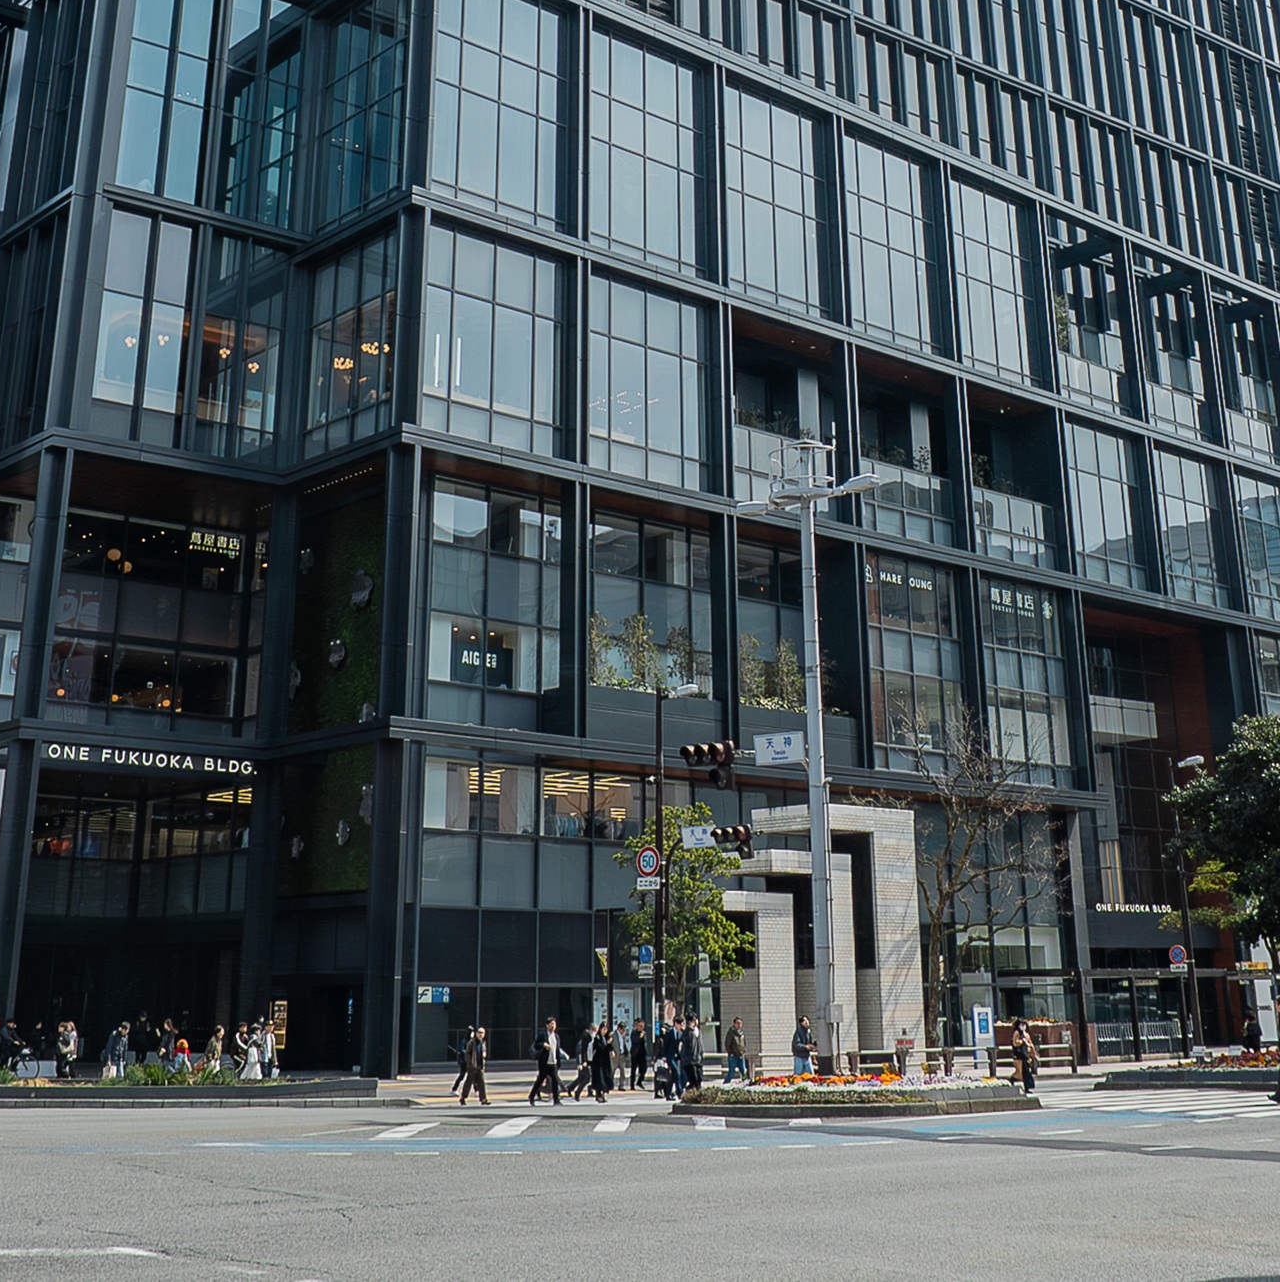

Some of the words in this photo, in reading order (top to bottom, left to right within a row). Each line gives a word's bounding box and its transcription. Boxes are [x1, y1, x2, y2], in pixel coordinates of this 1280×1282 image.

[190, 531, 240, 550] 蔦屋書店
[879, 570, 902, 585] HARE
[461, 649, 492, 668] AIGE
[765, 736, 792, 750] 天神
[47, 743, 90, 761] ONE
[101, 748, 194, 769] FUKUOKA
[203, 757, 258, 775] BLDG.
[641, 854, 656, 869] 50
[1095, 902, 1113, 913] ONE
[1114, 903, 1151, 914] FUKUOKA
